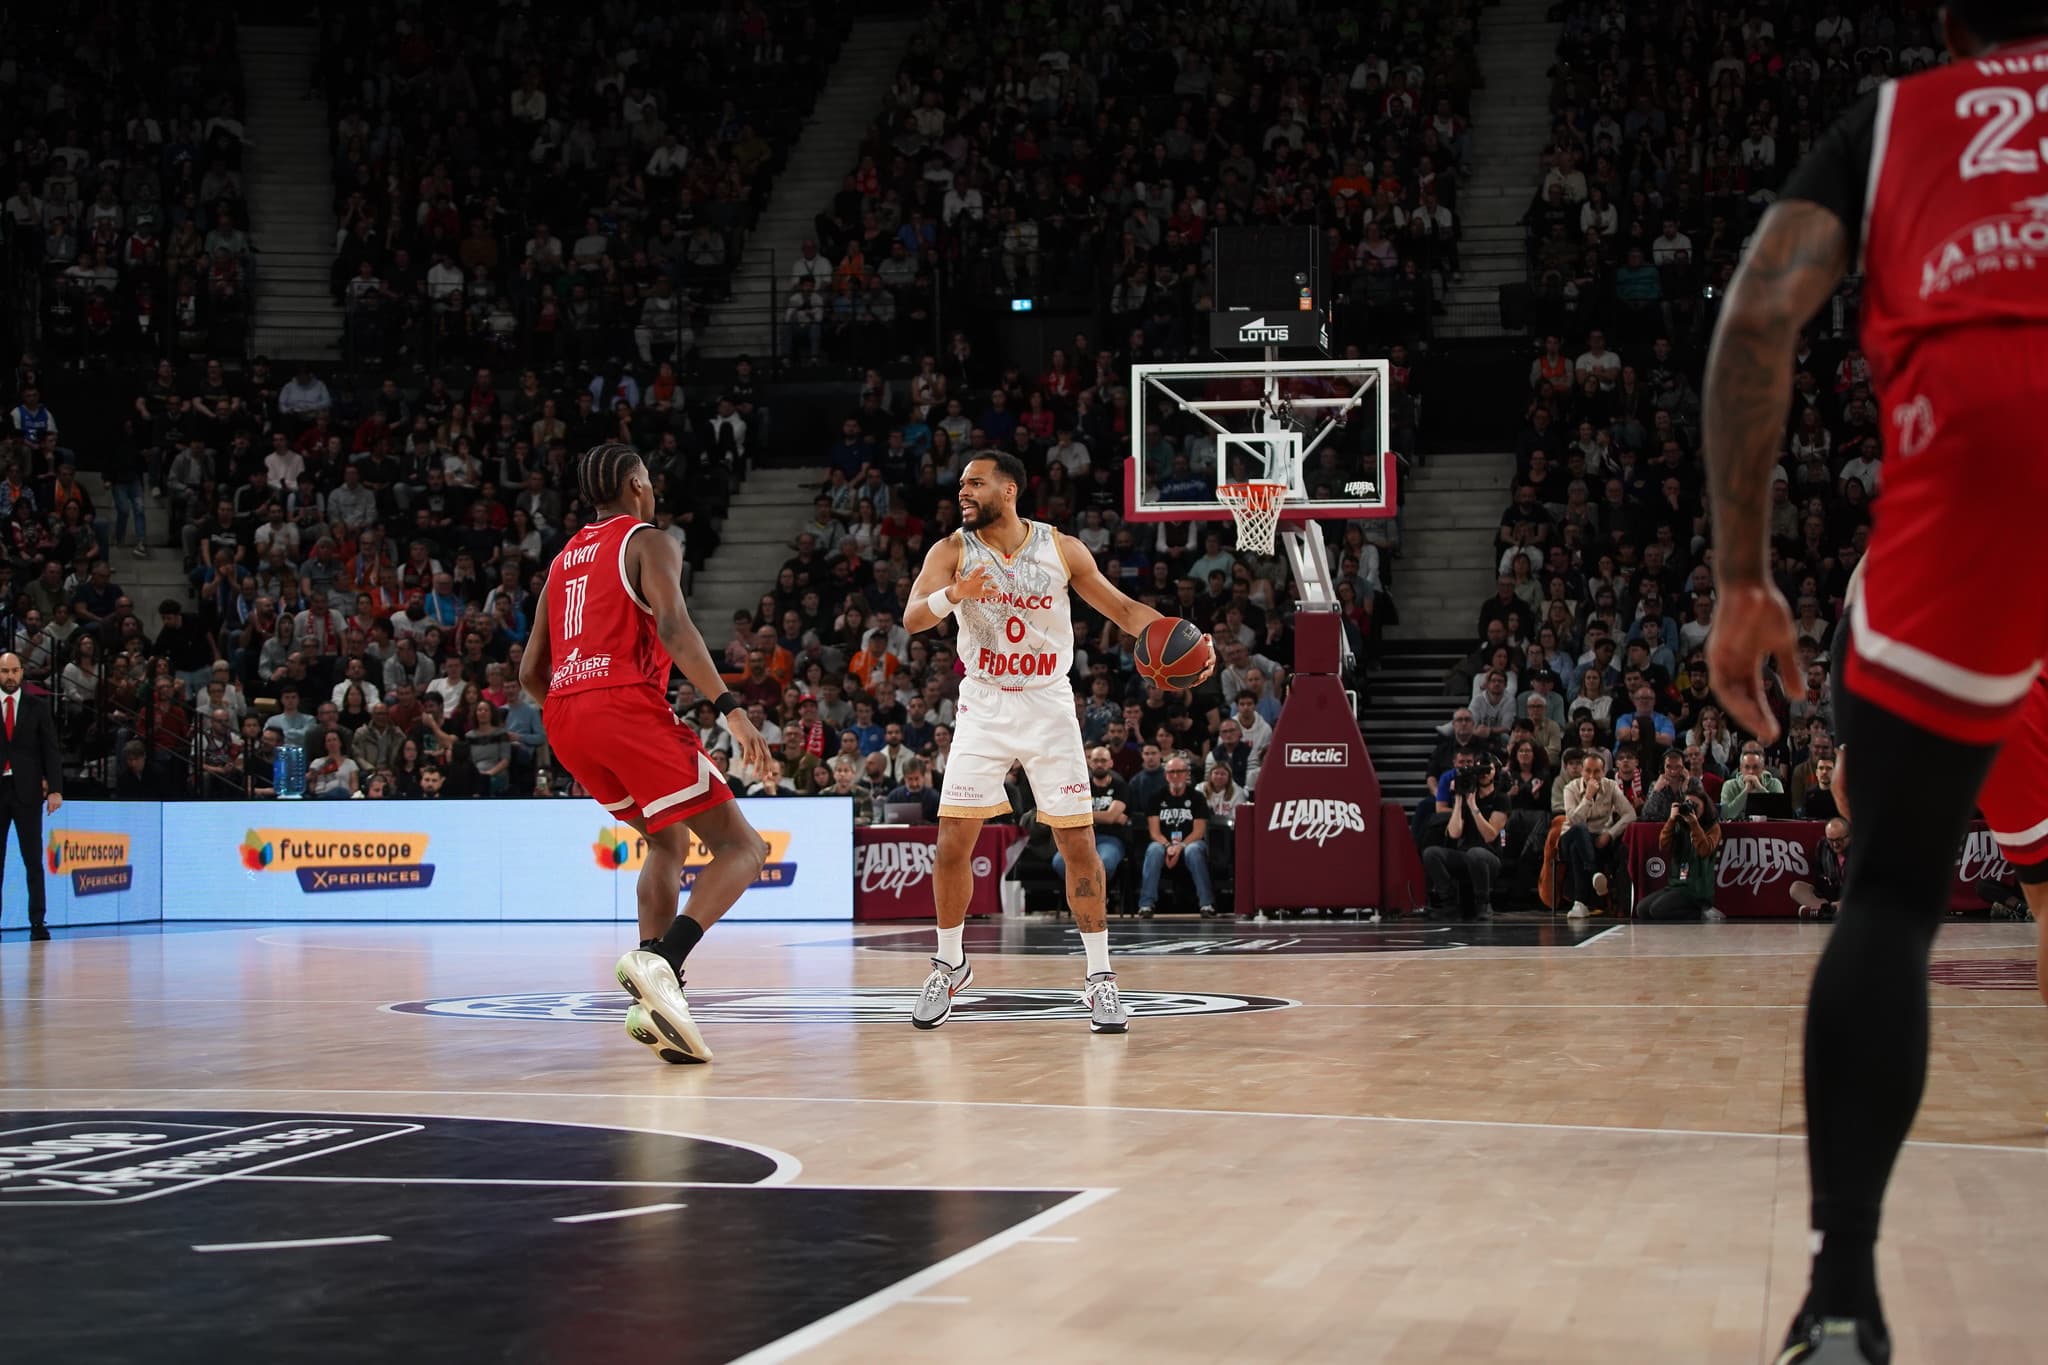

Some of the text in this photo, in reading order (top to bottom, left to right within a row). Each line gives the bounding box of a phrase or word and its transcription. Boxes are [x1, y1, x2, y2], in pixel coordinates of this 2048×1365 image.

[1955, 85, 2048, 179] 2
[1239, 330, 1289, 342] LOTUS
[563, 542, 601, 571] AYAYI
[565, 574, 589, 640] 11
[1006, 616, 1026, 643] 0
[979, 648, 1057, 676] FEDCOM
[1290, 747, 1343, 763] Betclic
[1268, 799, 1365, 831] LEADERS
[1289, 815, 1347, 848] Cup
[63, 839, 125, 865] futuroscope
[280, 838, 411, 864] futuroscope
[861, 861, 924, 900] Cup
[1716, 855, 1785, 897] Cup
